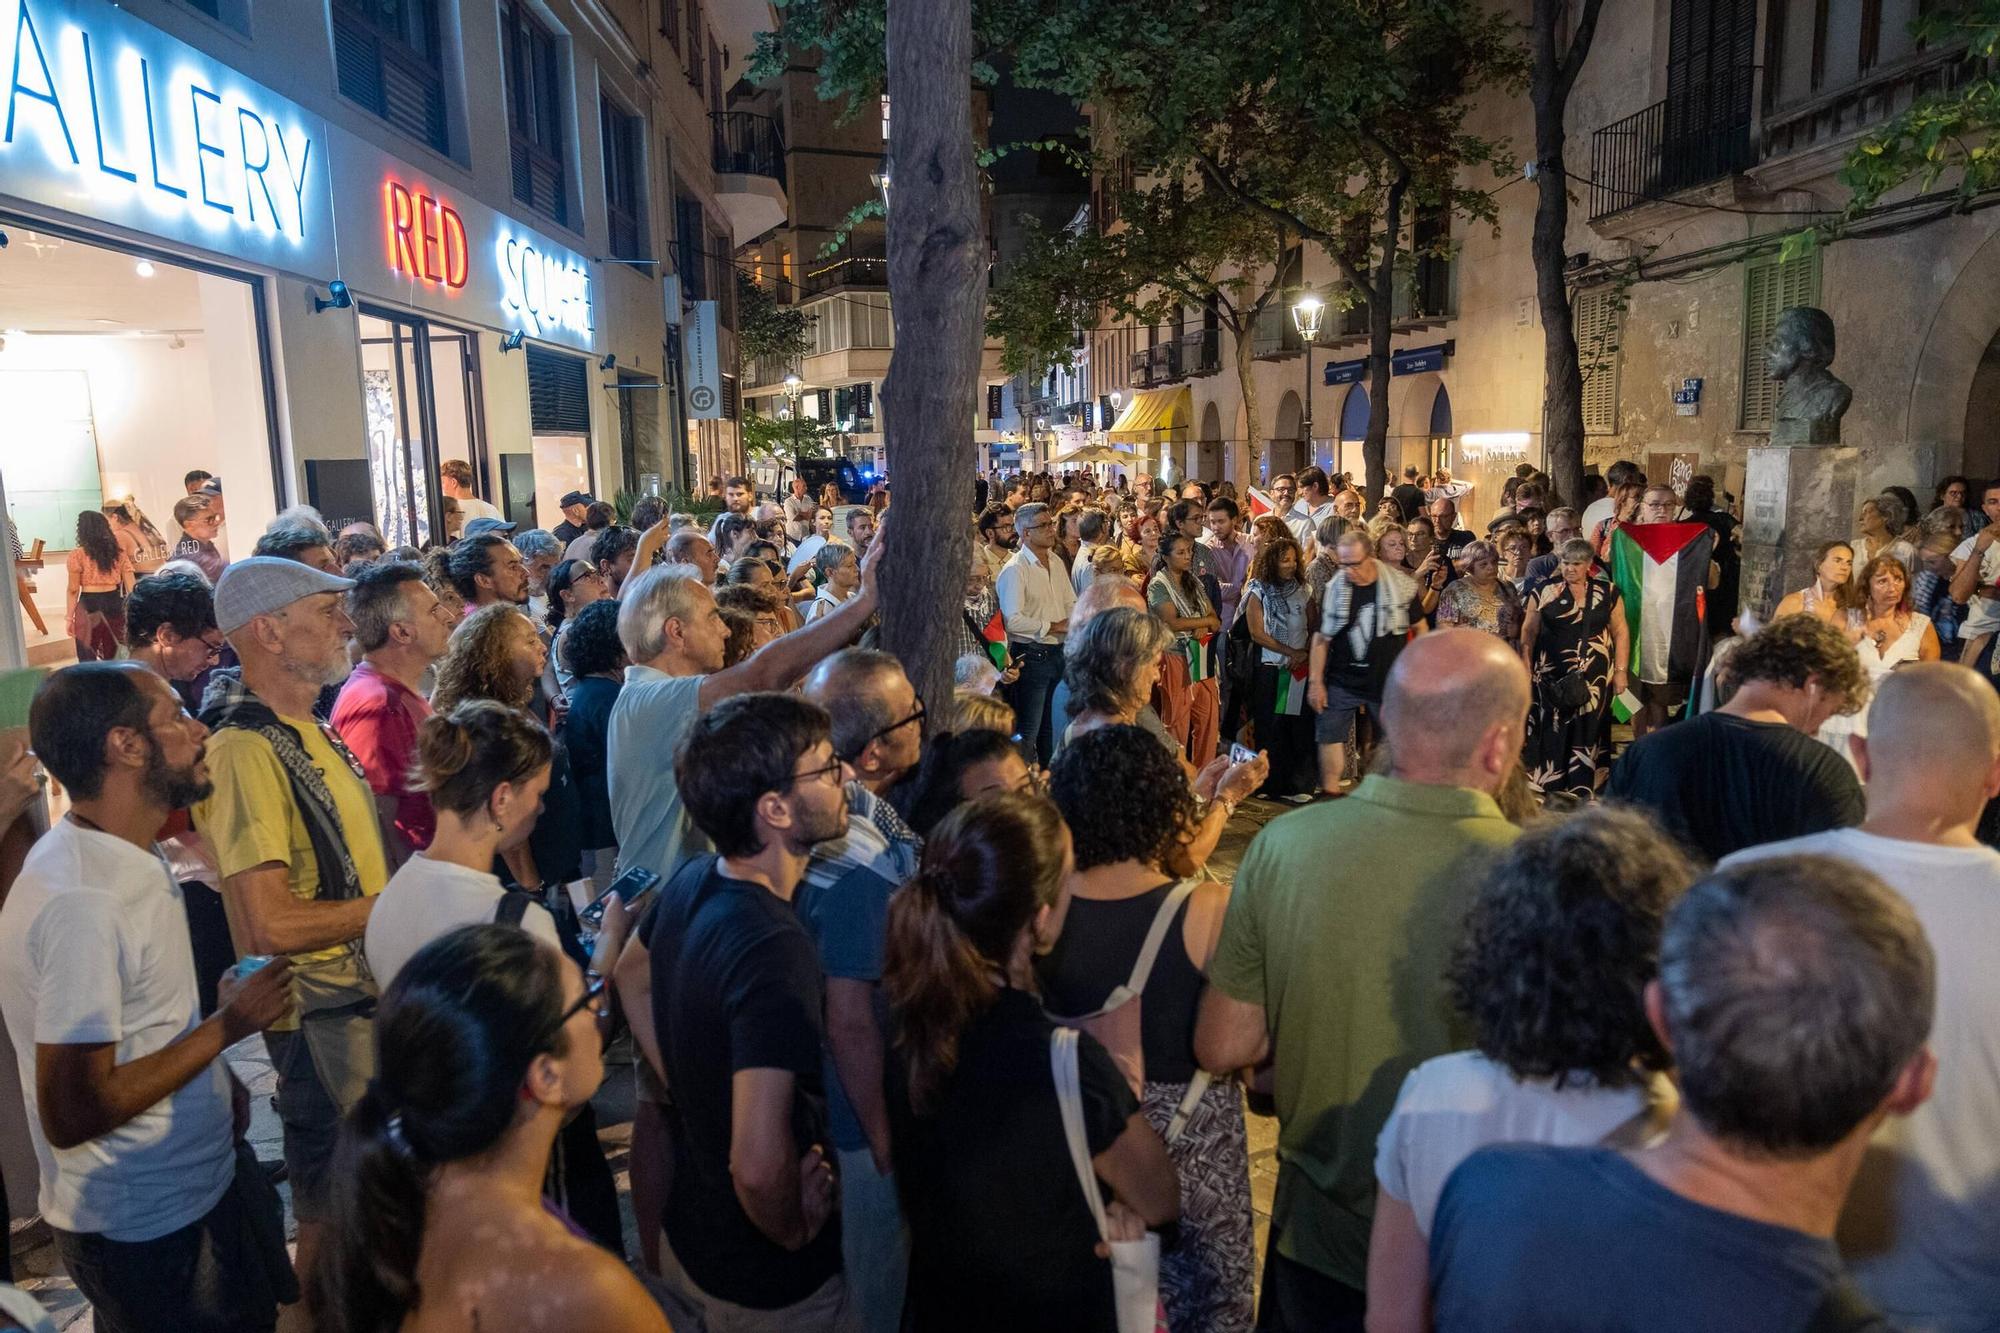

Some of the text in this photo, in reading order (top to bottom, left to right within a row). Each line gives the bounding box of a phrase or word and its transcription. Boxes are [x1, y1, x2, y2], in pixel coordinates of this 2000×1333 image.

[5, 0, 310, 237] ALLERY
[390, 181, 469, 289] RED
[181, 540, 200, 554] RED
